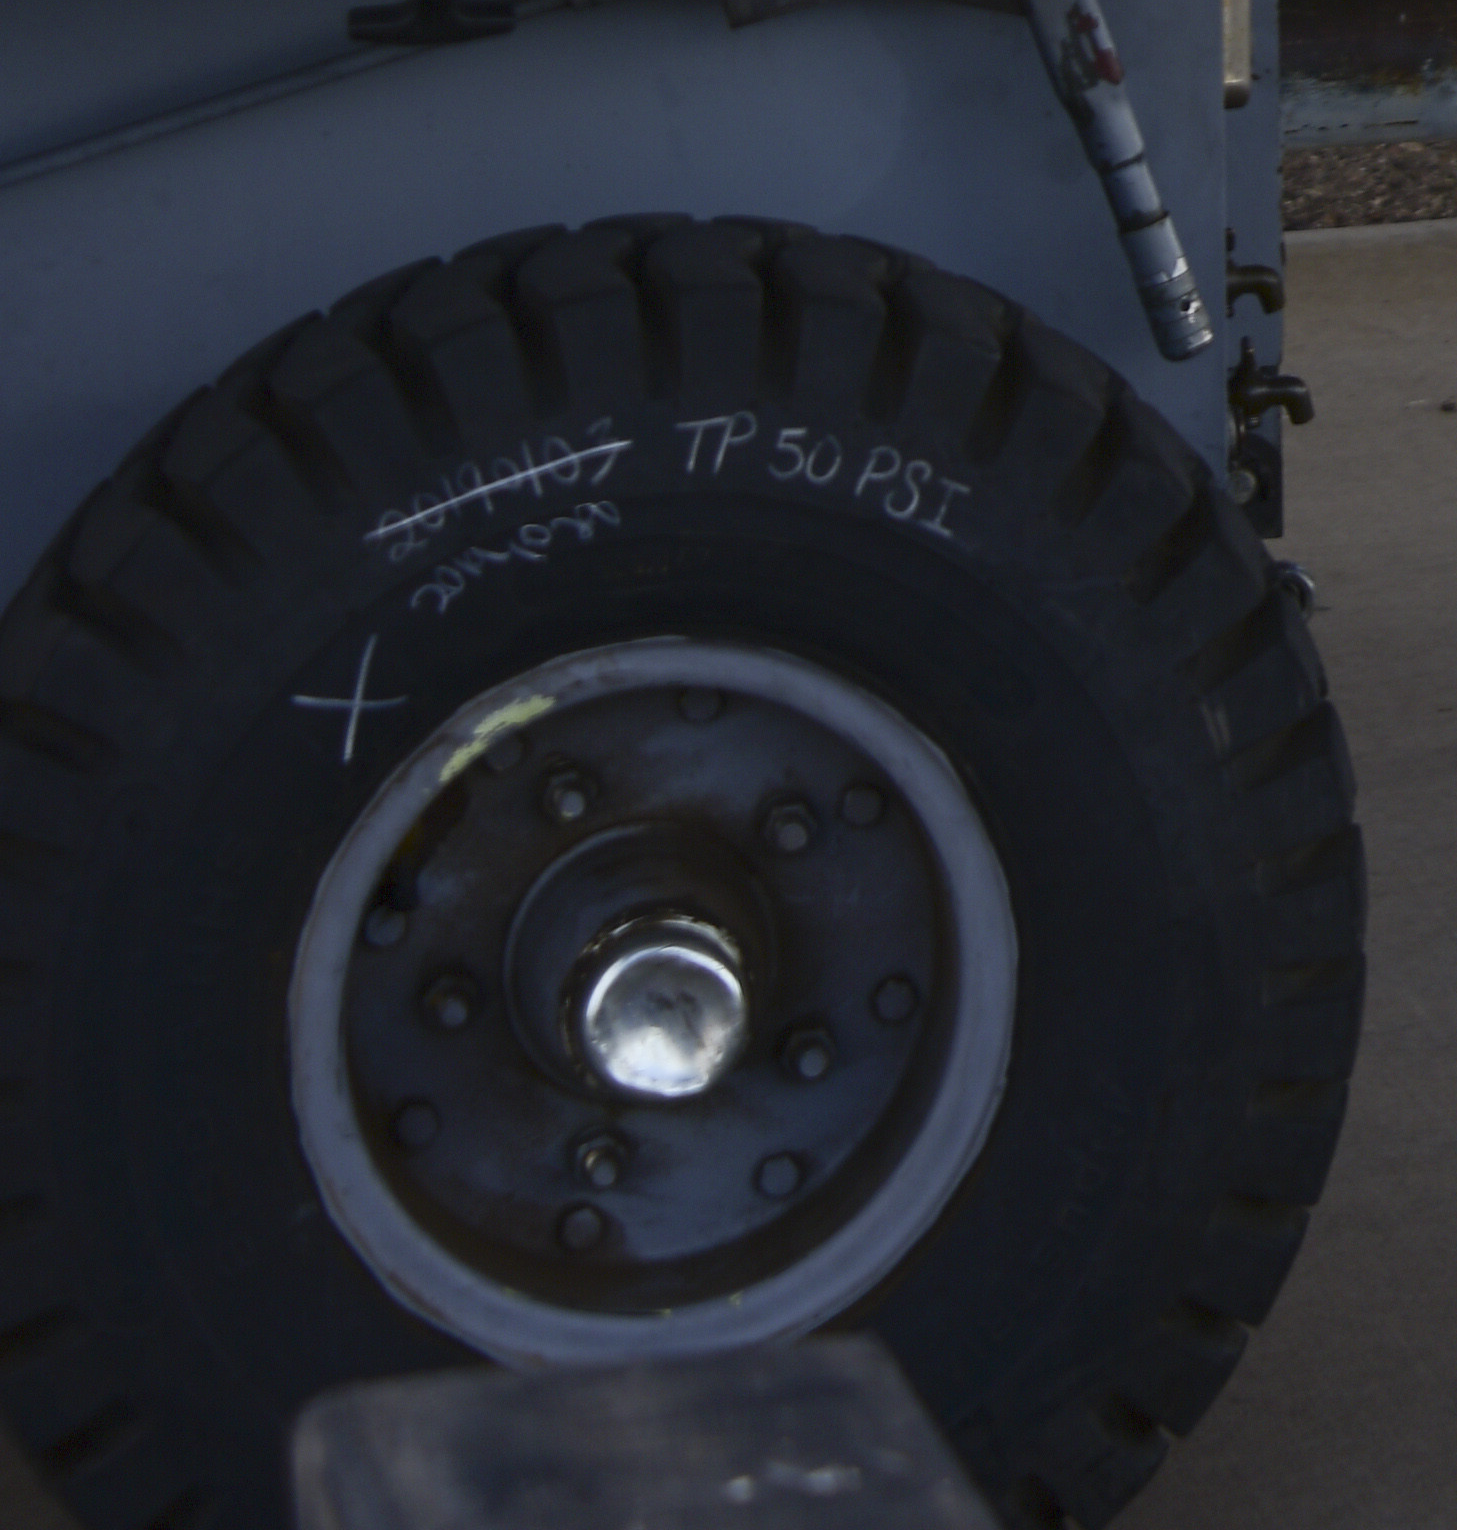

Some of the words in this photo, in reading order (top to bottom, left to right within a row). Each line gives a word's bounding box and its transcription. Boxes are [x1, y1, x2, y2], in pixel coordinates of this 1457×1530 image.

[676, 412, 757, 473] TP
[772, 427, 842, 484] 50
[854, 446, 971, 539] PSI
